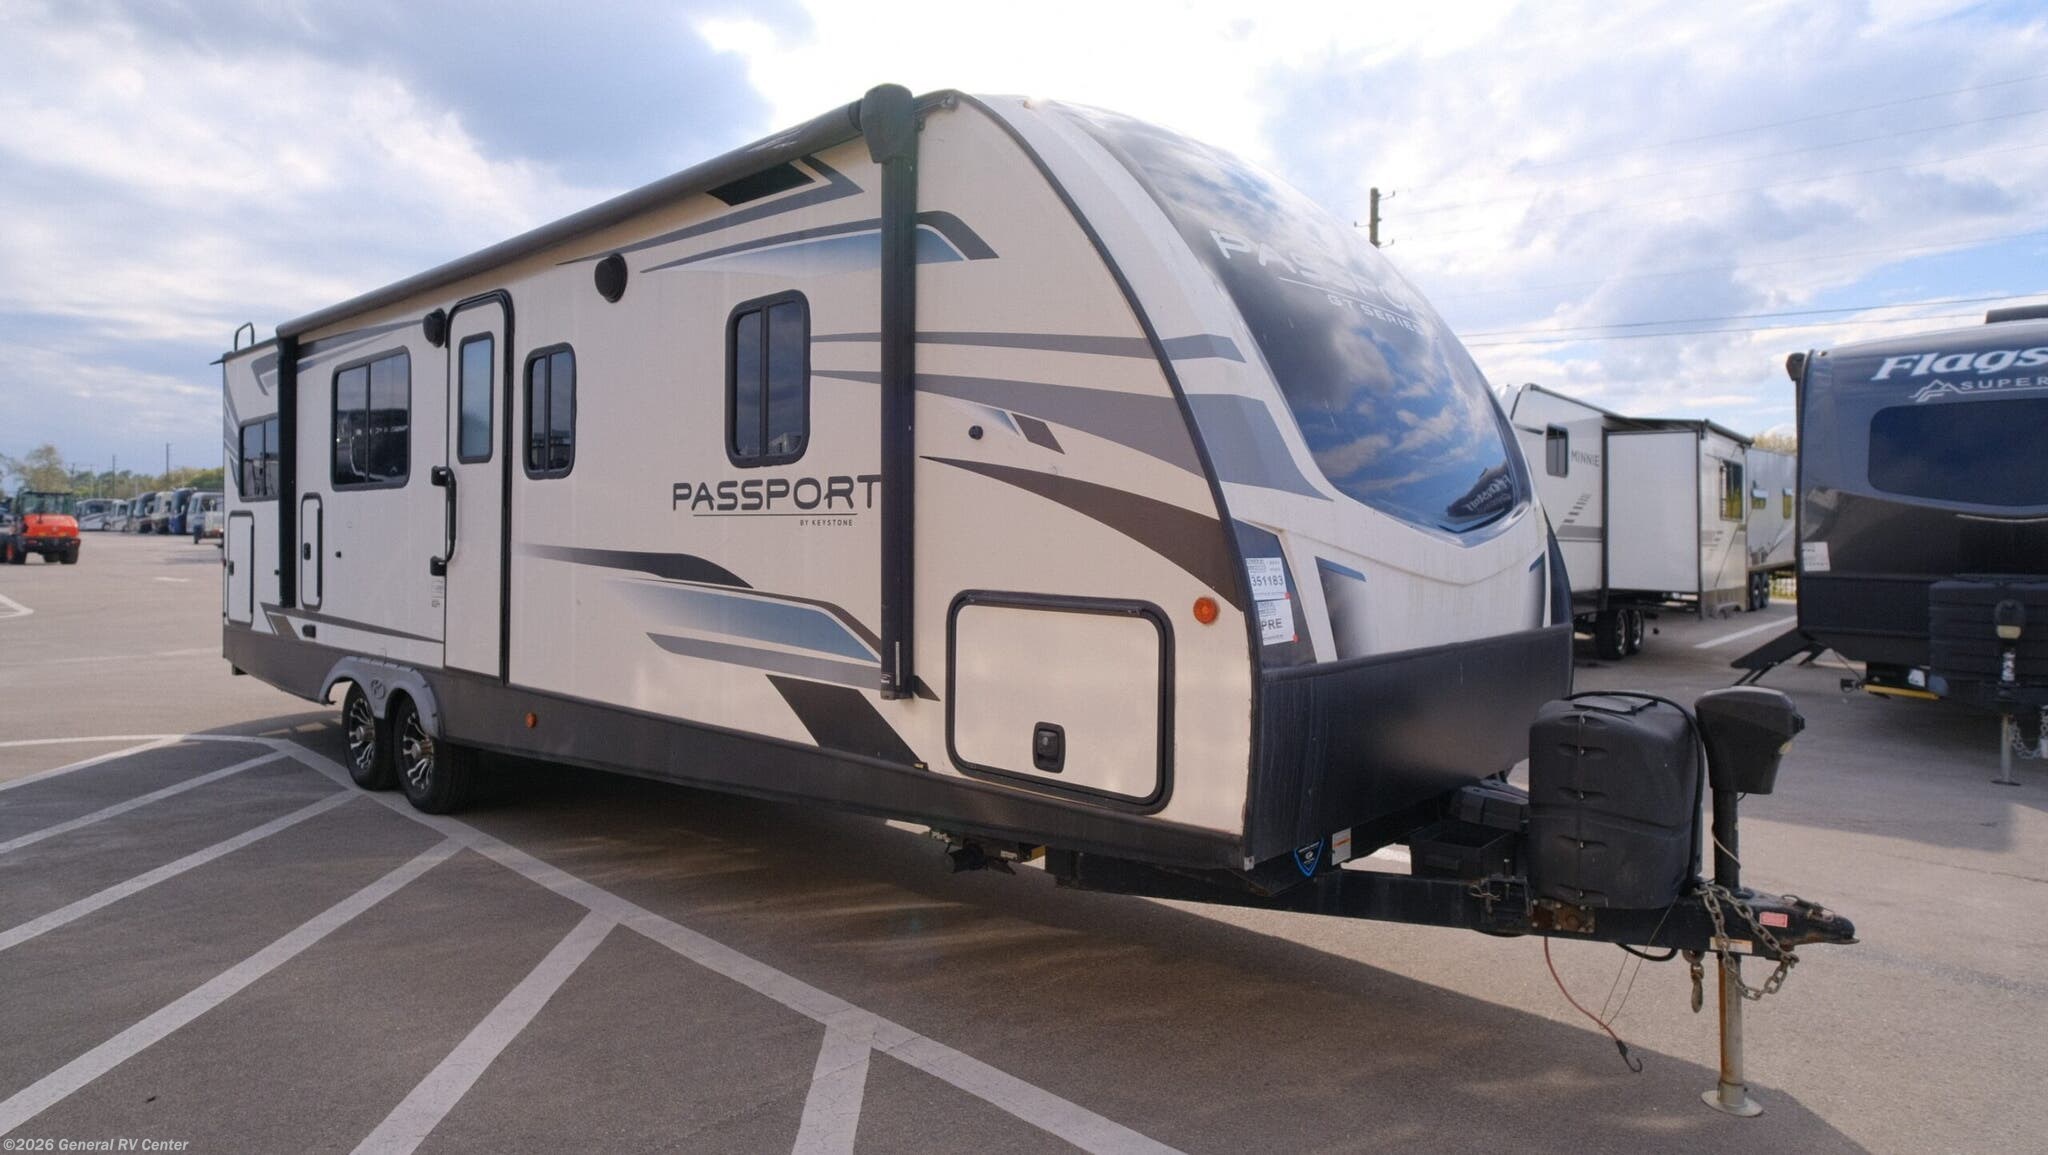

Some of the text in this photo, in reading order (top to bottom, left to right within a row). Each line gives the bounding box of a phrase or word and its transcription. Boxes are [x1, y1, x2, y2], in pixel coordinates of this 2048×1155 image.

[1871, 347, 2048, 381] Flags
[1960, 376, 2048, 390] SUPER
[672, 474, 881, 511] PASSPORT
[811, 519, 853, 527] KEYSTONE
[1251, 575, 1284, 587] 351183
[1261, 618, 1283, 630] PRE
